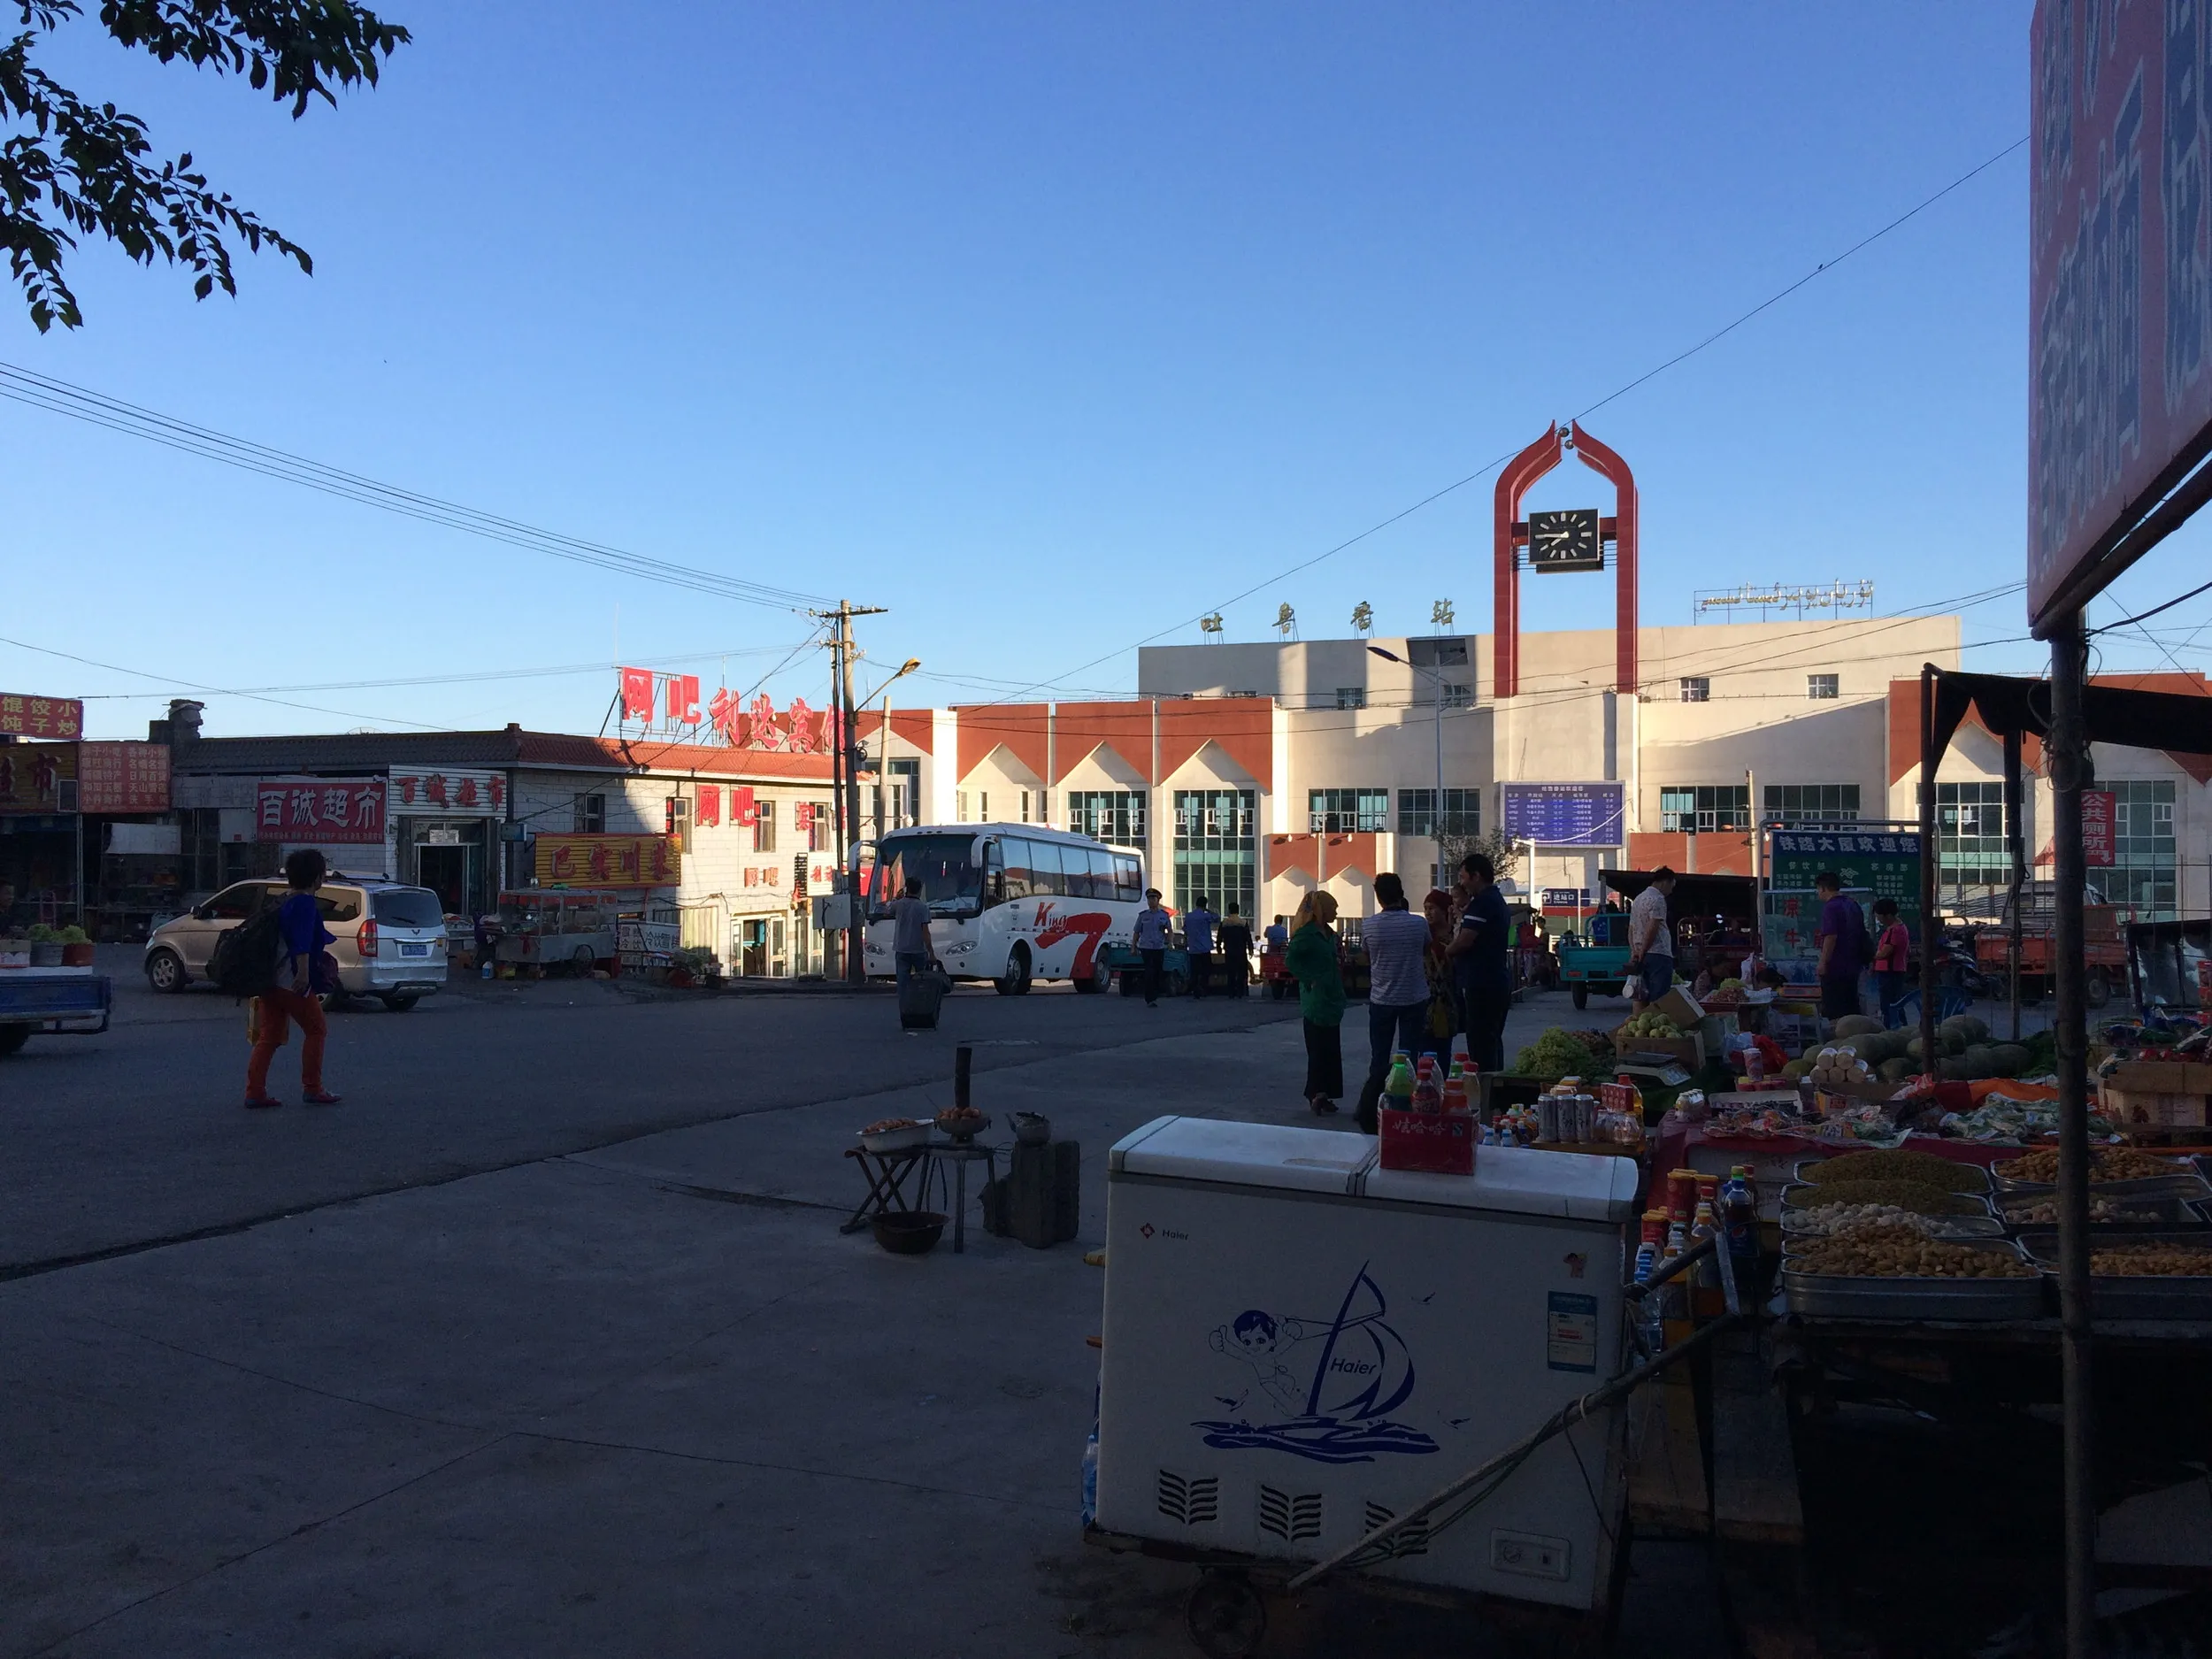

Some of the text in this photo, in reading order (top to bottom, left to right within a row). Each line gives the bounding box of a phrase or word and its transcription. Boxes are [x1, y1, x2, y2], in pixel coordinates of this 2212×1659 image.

[1201, 597, 1455, 634] 吐鲁番站
[622, 667, 702, 725] 网吧
[1, 696, 24, 732] 馄饨
[30, 699, 51, 733] 饺子
[58, 702, 78, 735] 小炒
[259, 786, 383, 829] 百诚超市
[396, 773, 506, 810] 百诚超市
[697, 784, 755, 827] 网吧
[2081, 794, 2108, 849] 公共厕所
[1778, 836, 1918, 852] 铁路大厦欢迎您
[1033, 902, 1067, 932] King
[1392, 1117, 1446, 1135] 娃哈哈
[1162, 1229, 1189, 1240] Haier
[1331, 1357, 1377, 1375] Haier
